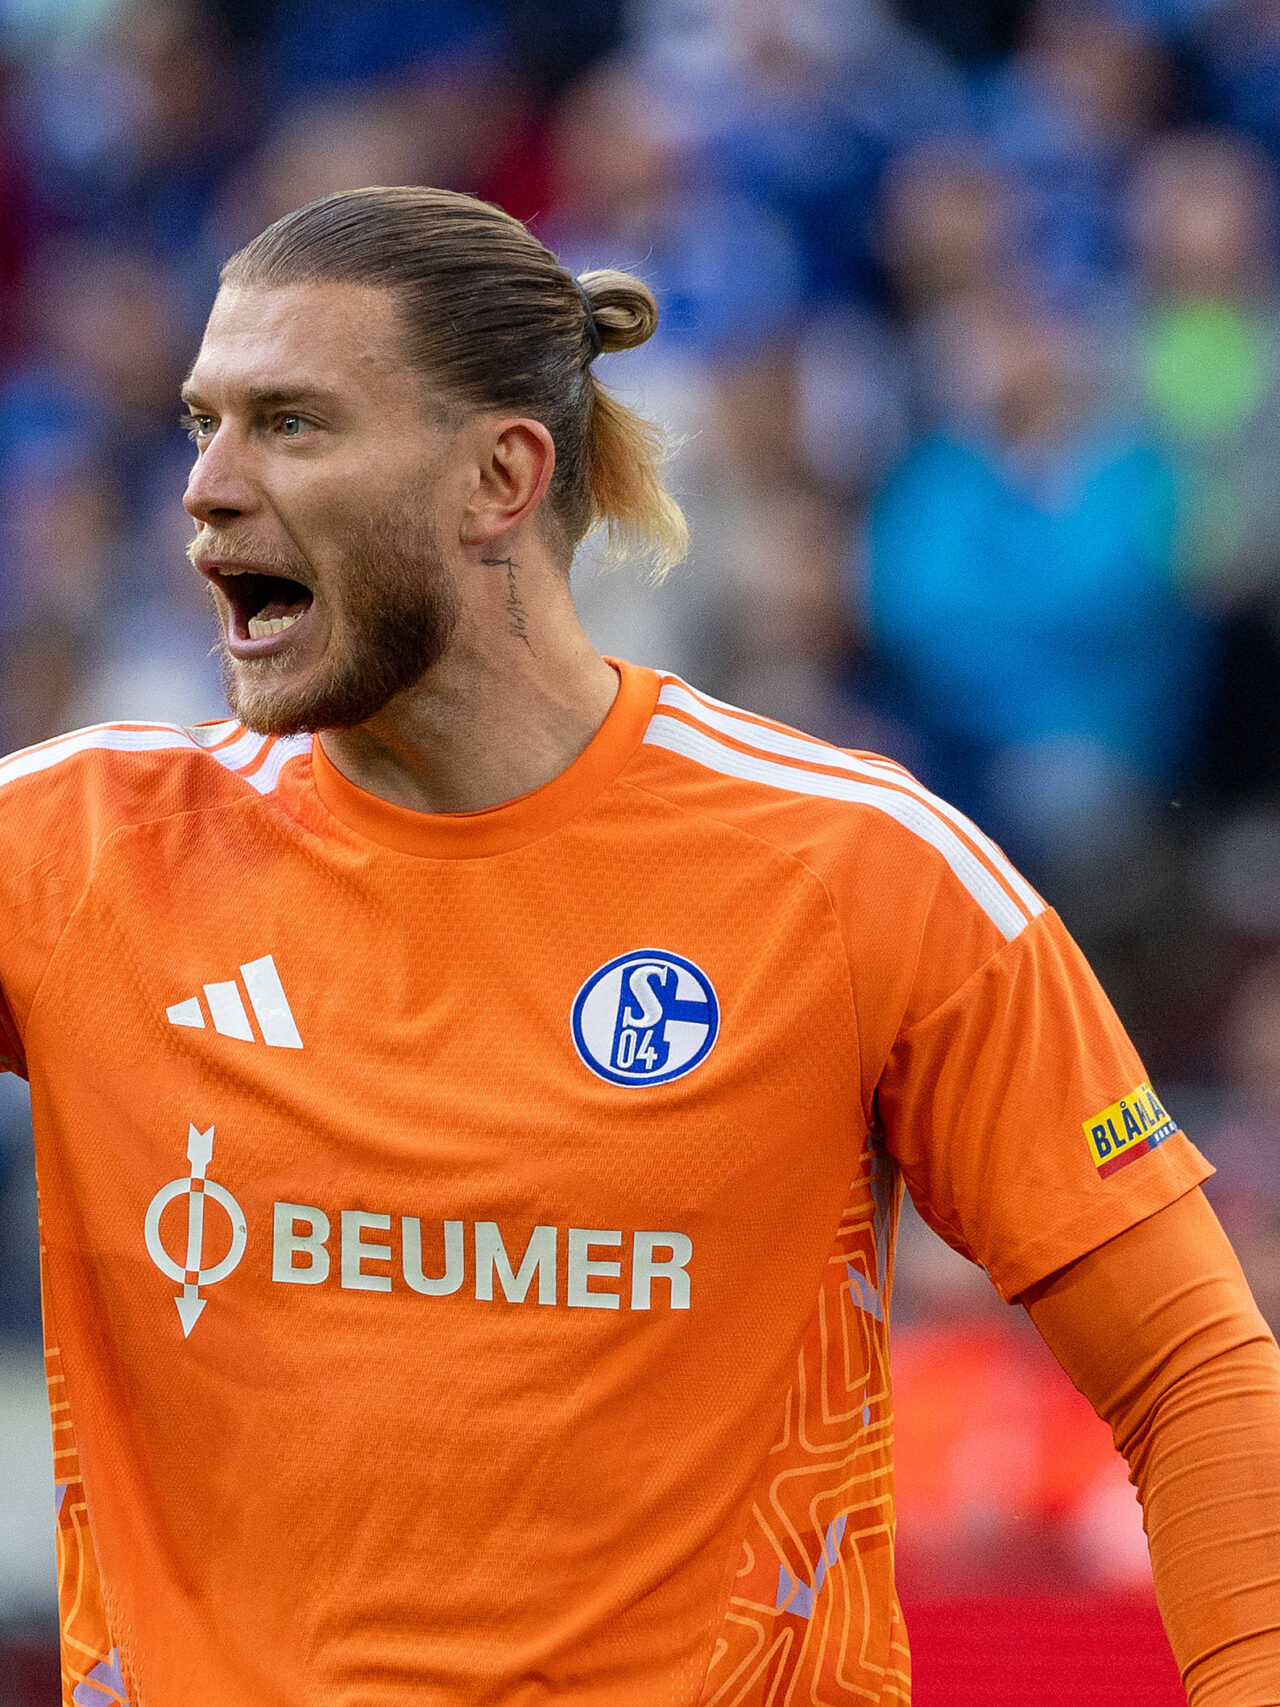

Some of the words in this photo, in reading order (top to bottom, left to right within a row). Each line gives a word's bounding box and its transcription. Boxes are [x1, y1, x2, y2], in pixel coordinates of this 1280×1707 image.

[622, 965, 669, 1029] S
[616, 1028, 658, 1070] 04
[271, 1201, 694, 1310] BEUMER
